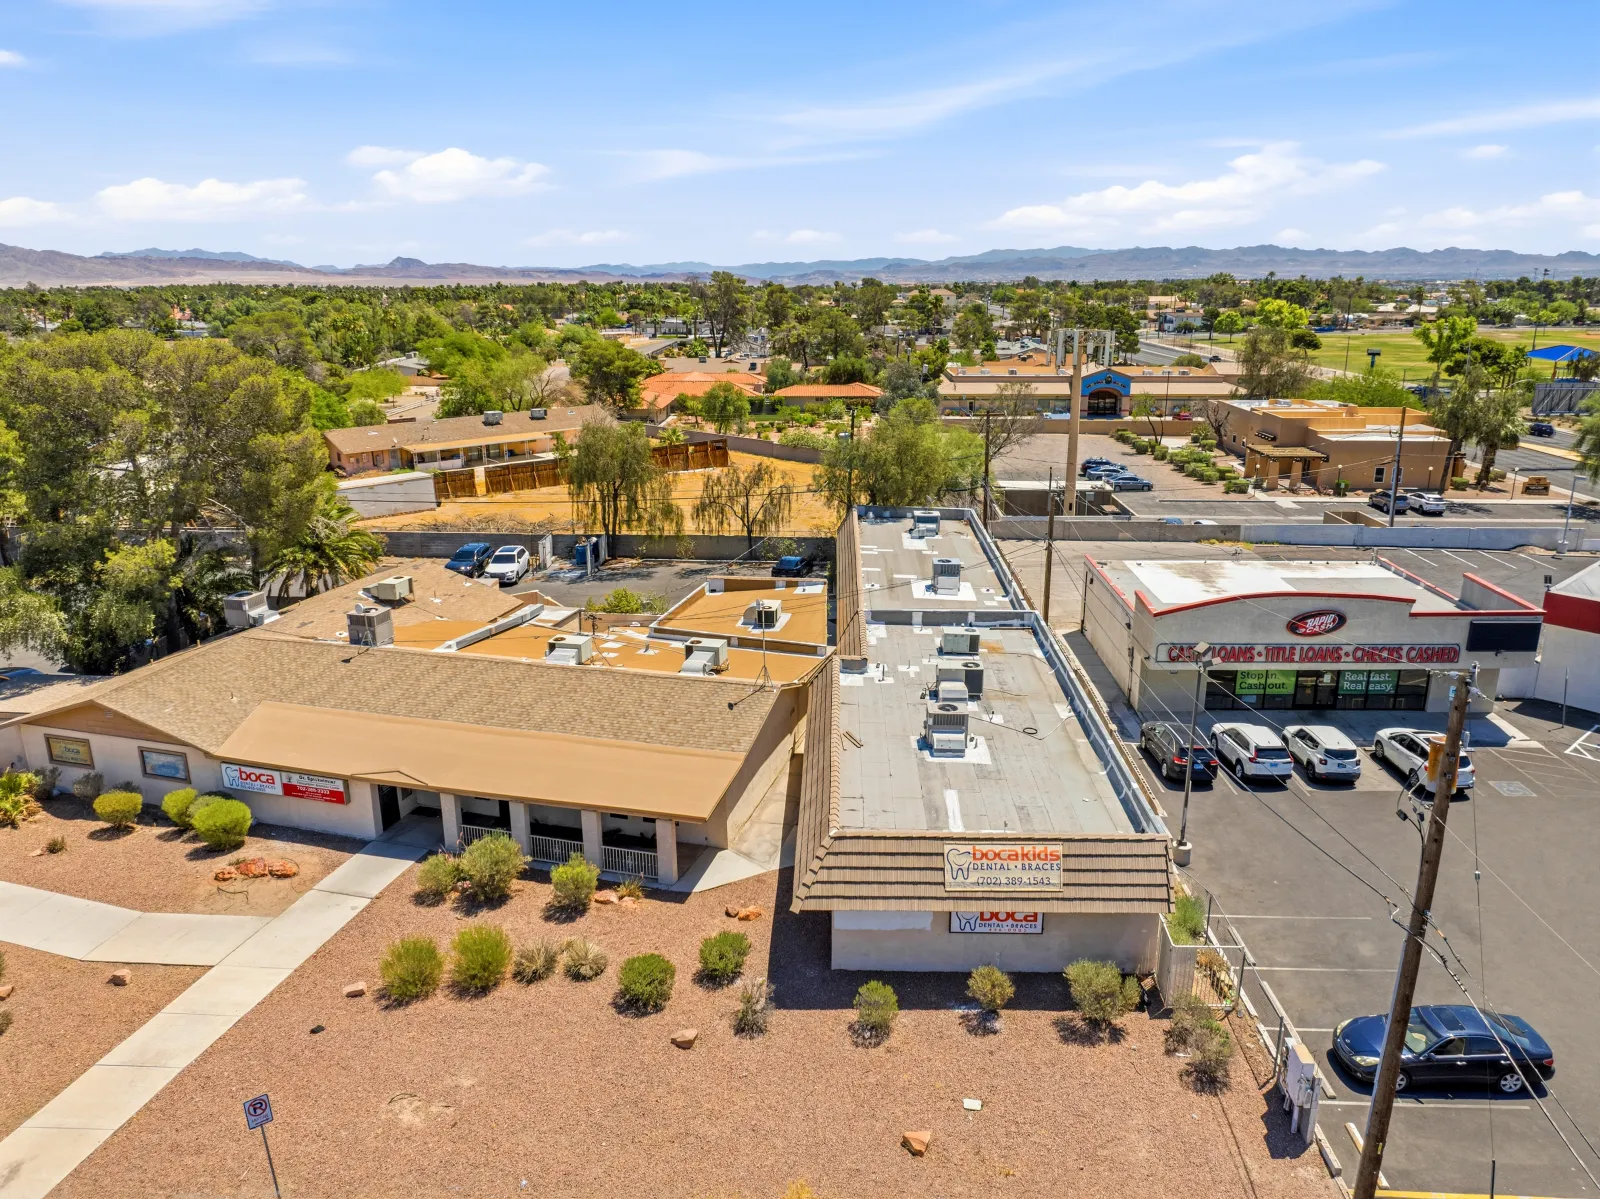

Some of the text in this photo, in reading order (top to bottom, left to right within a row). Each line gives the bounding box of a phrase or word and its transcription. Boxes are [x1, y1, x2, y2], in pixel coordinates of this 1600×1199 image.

[1306, 614, 1335, 628] RAPID
[1306, 622, 1334, 633] CASH
[1168, 646, 1459, 663] CAS LOANS TITLE LOANS CHECKS CASHED
[1240, 671, 1280, 682] Stop in.
[1344, 671, 1392, 681] Real fast.
[1239, 681, 1288, 691] Cash out.
[1343, 681, 1394, 693] Real easy.
[239, 767, 276, 785] boca
[972, 863, 1061, 871] DENTAL BRACES
[976, 876, 1051, 886] (702) 389-1543
